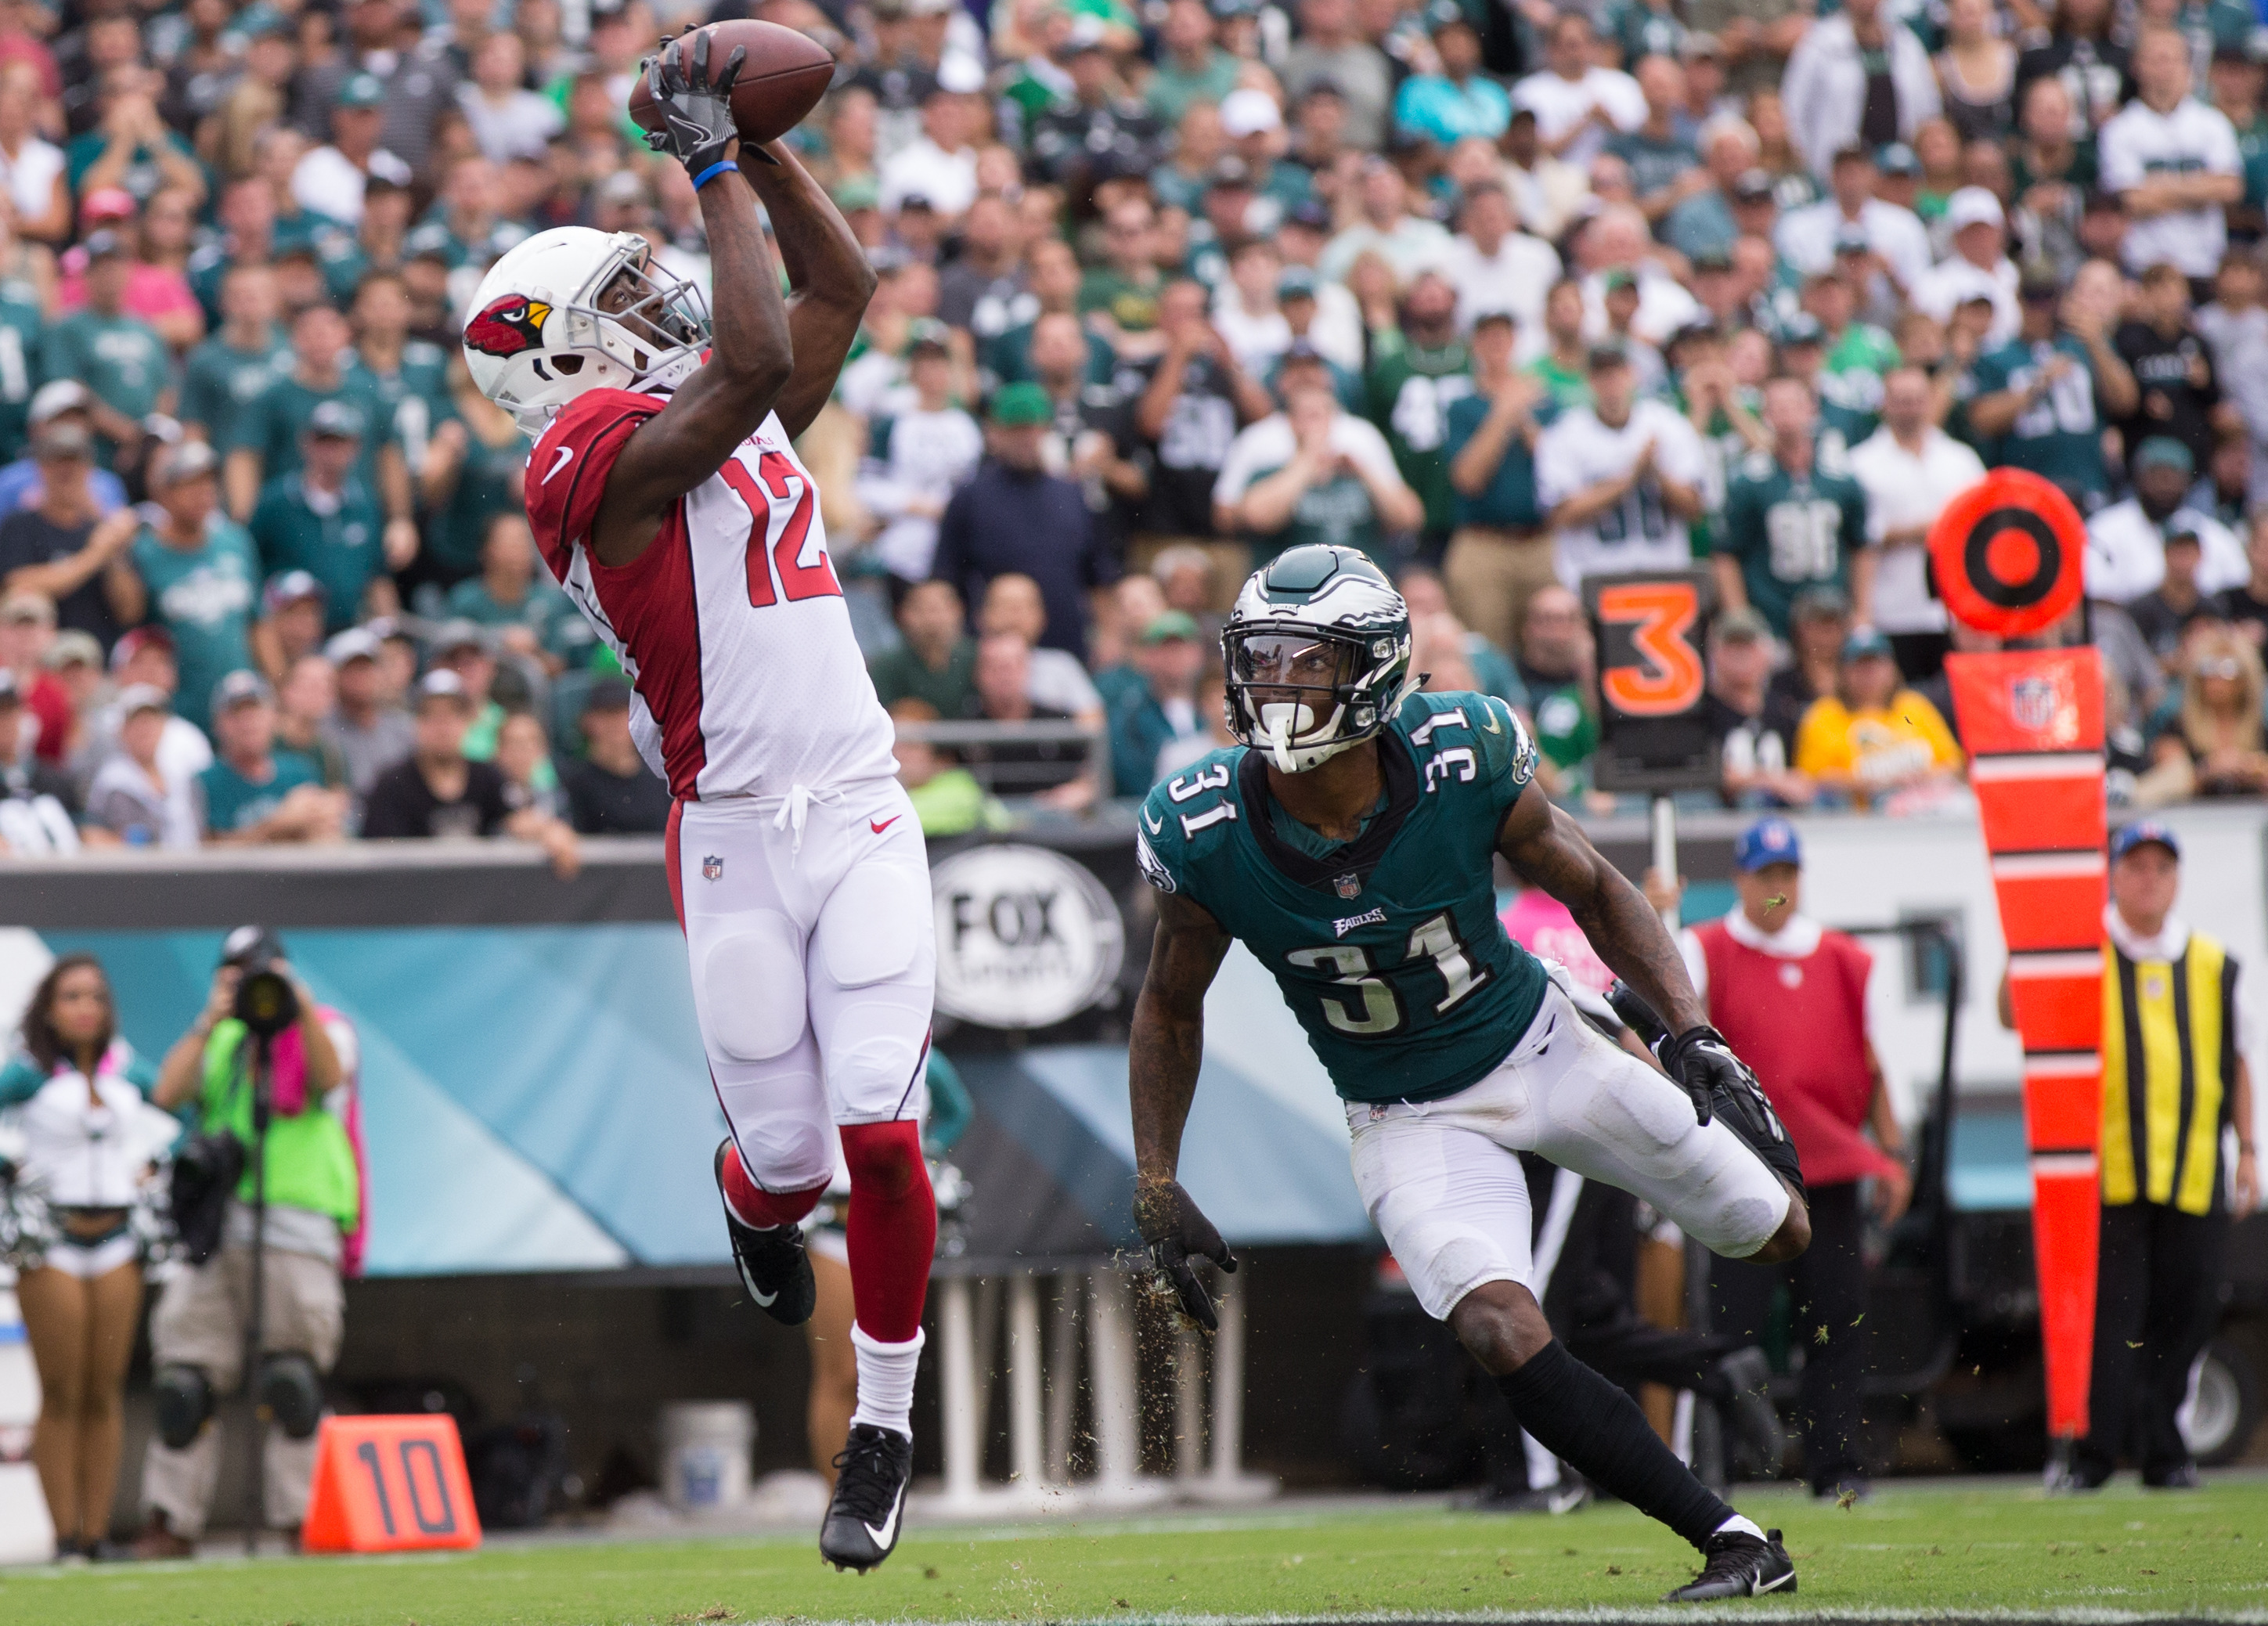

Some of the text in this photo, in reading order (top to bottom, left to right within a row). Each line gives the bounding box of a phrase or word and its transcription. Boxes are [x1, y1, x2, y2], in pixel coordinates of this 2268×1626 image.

[718, 451, 843, 608] 12
[1598, 582, 1704, 716] 3
[1408, 706, 1477, 794] 31
[1167, 764, 1238, 842] 31
[950, 889, 1067, 952] FOX
[1332, 907, 1387, 939] EAGLES
[1284, 910, 1492, 1037] 31
[358, 1440, 456, 1537] 10
